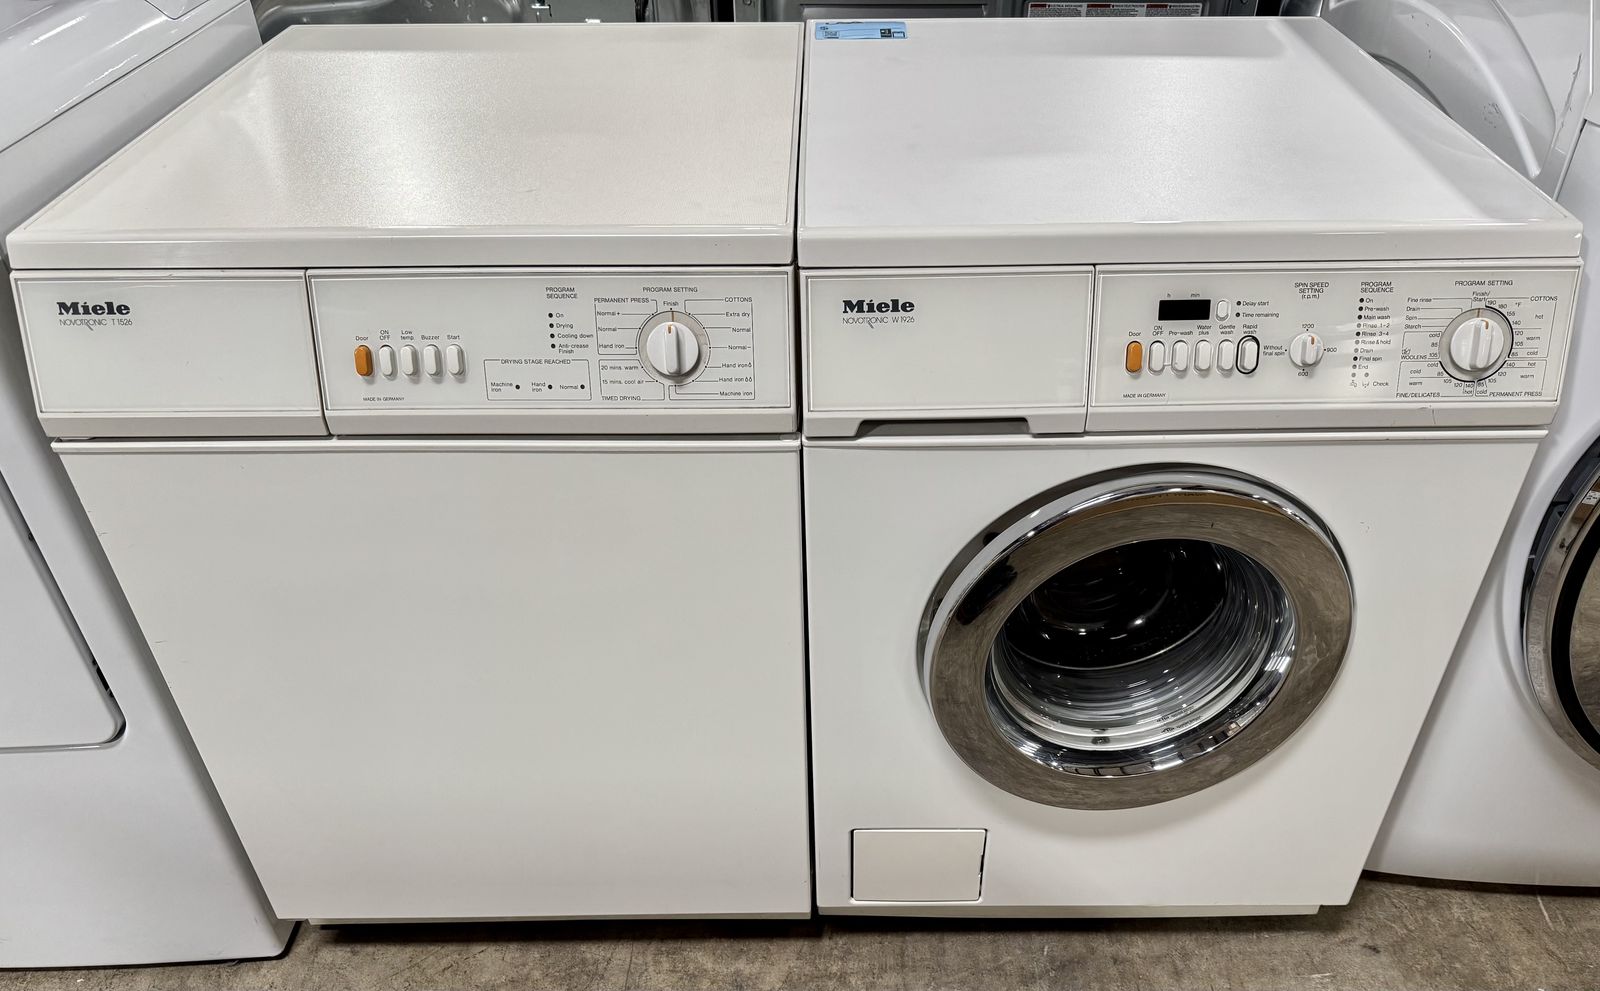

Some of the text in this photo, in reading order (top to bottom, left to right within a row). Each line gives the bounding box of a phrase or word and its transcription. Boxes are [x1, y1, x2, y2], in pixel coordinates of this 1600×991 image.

[57, 302, 130, 315] Miele
[843, 299, 914, 313] Miele
[59, 319, 107, 331] NOVOTRONIC
[843, 317, 888, 329] NOVOTRONIC
